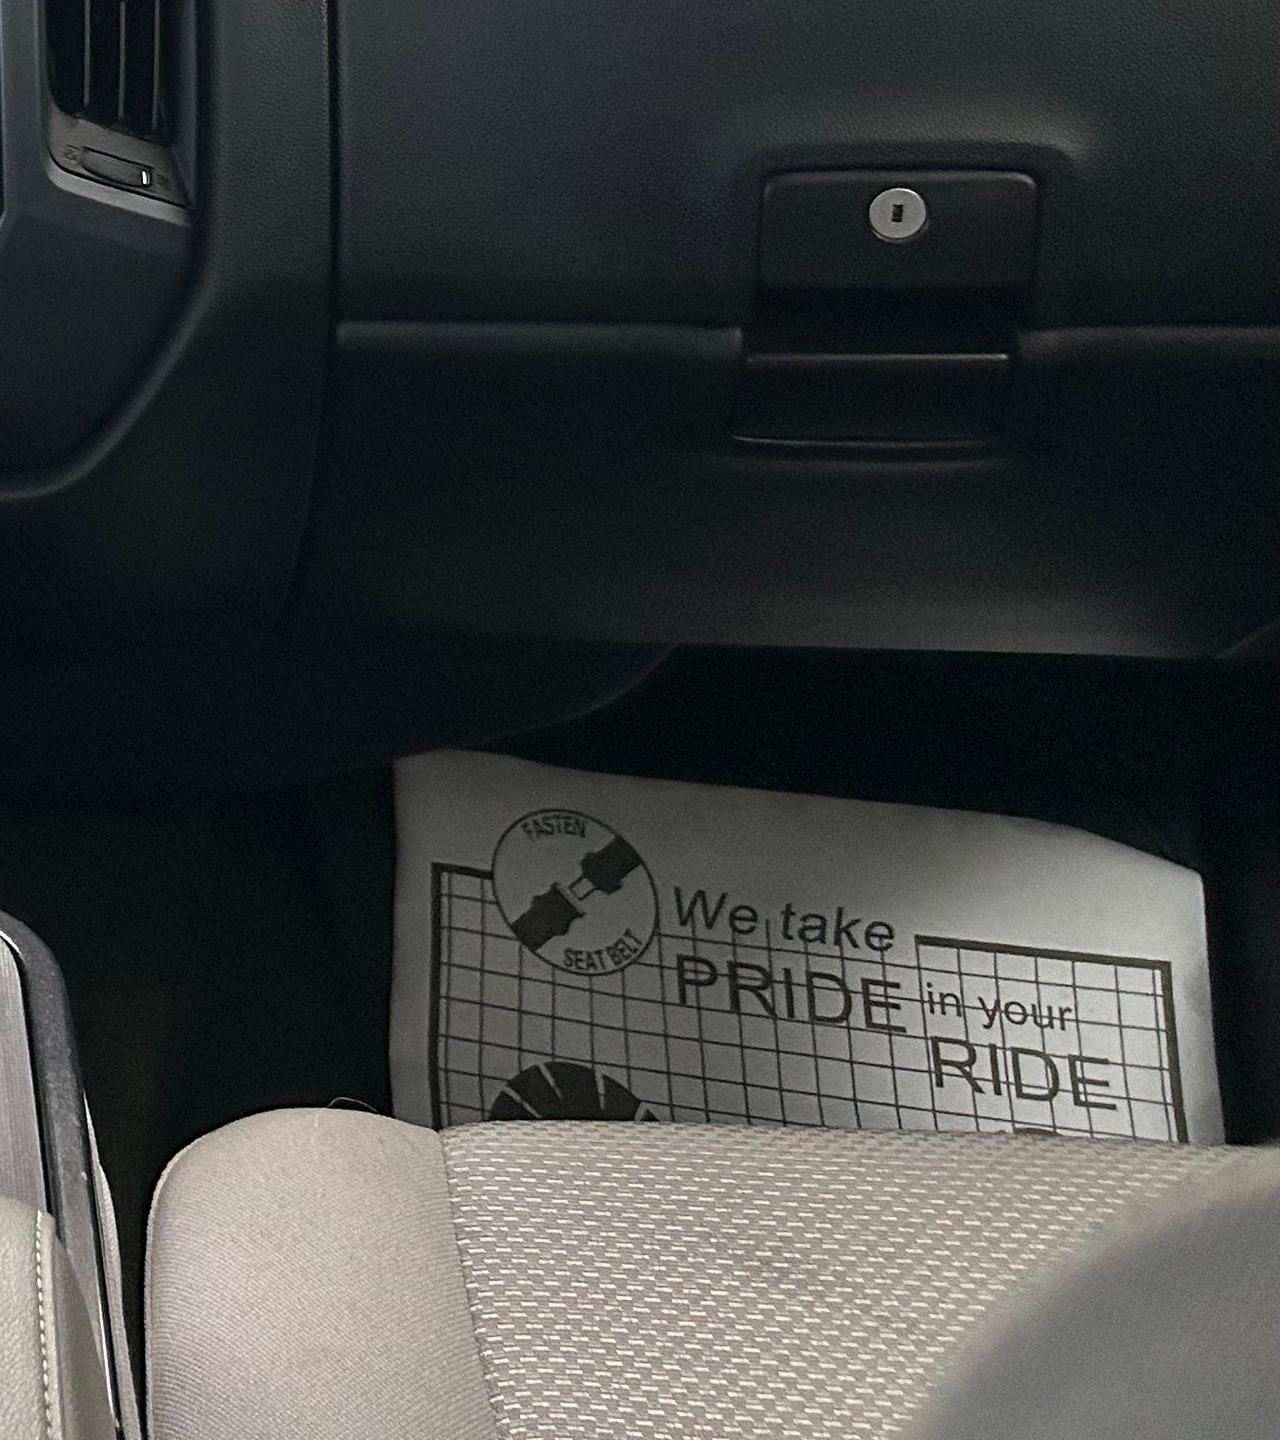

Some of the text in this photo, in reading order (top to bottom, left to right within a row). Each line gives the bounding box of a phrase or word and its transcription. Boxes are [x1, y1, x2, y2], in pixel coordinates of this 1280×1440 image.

[521, 814, 586, 840] FASTEN
[674, 886, 896, 952] We take
[563, 928, 643, 971] SEAT BELT
[676, 953, 908, 1034] PRIDE
[925, 981, 1074, 1031] in your
[930, 1035, 1118, 1112] RIDE
